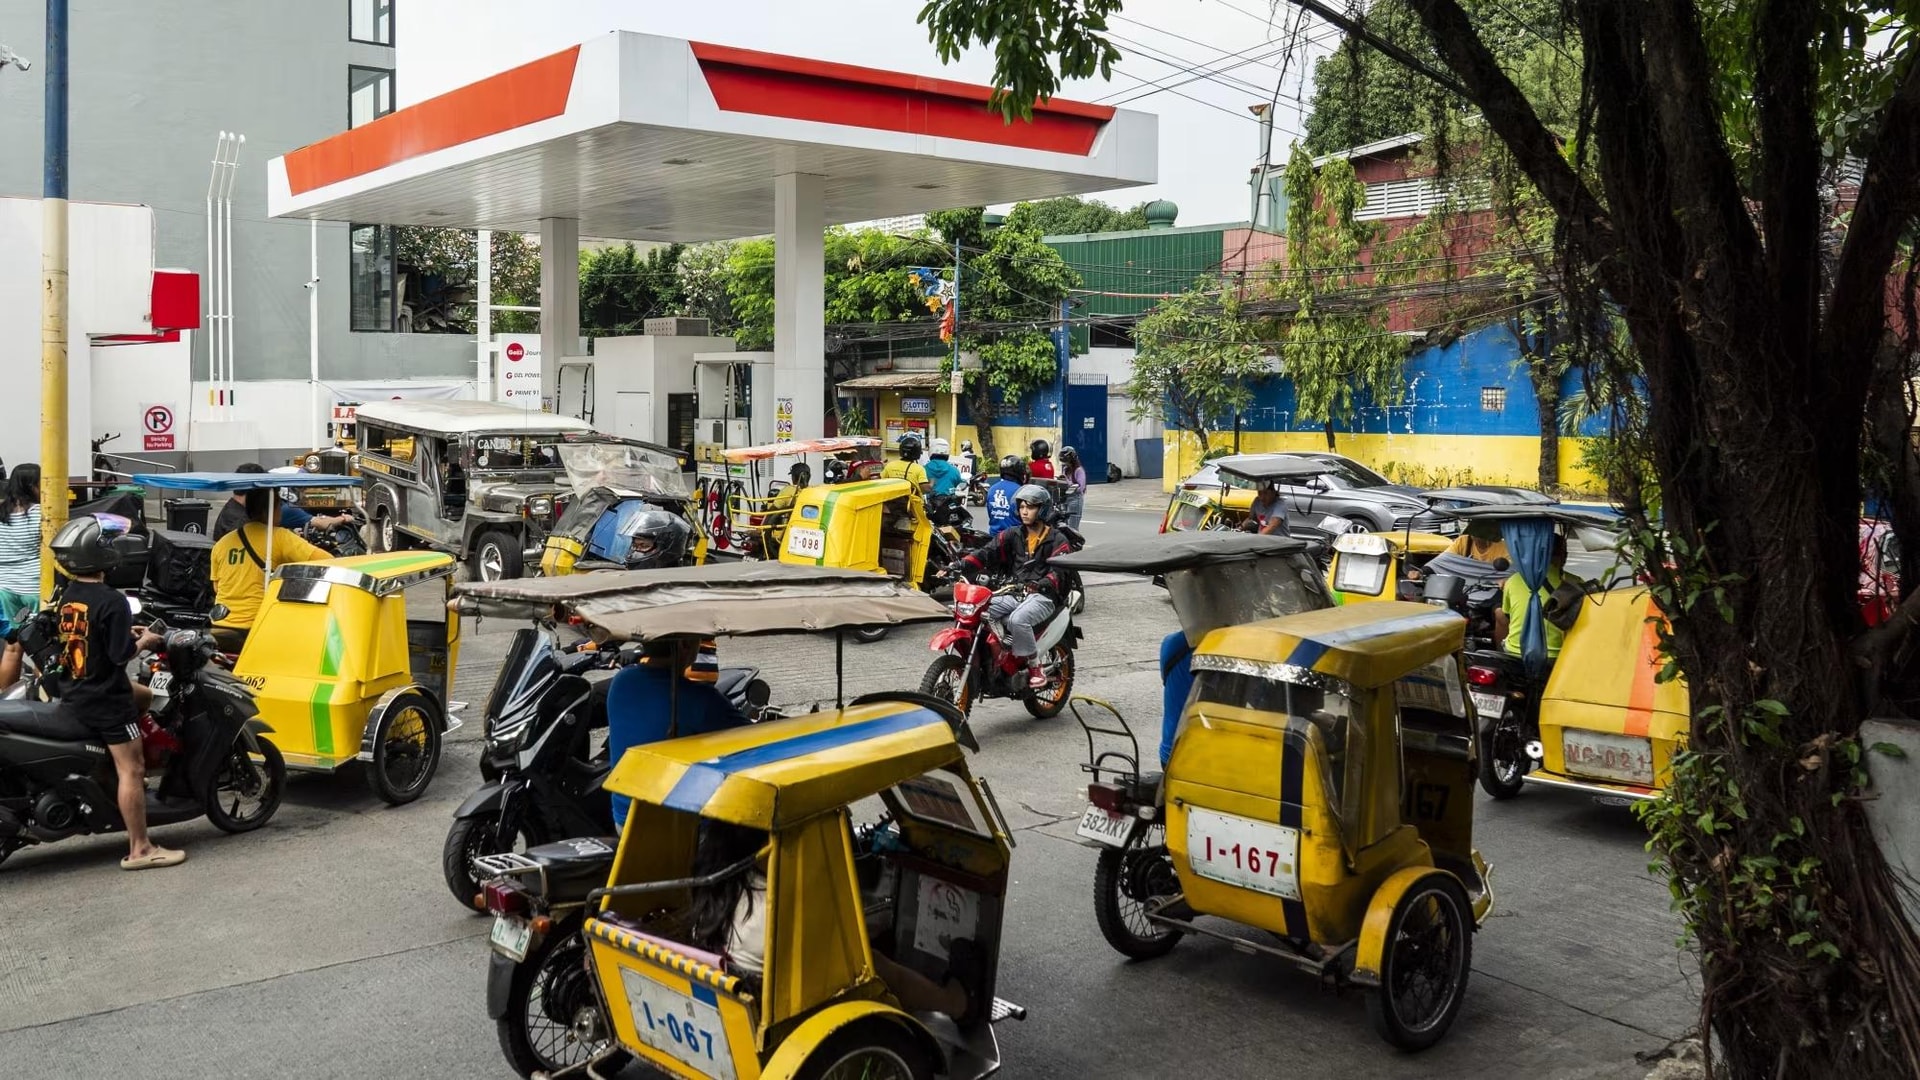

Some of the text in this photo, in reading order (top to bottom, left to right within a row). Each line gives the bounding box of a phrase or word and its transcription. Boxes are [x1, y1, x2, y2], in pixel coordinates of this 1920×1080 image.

[909, 401, 929, 409] LOTTO
[794, 536, 819, 550] T-098
[228, 547, 246, 565] 61
[1081, 812, 1130, 840] 382XKY
